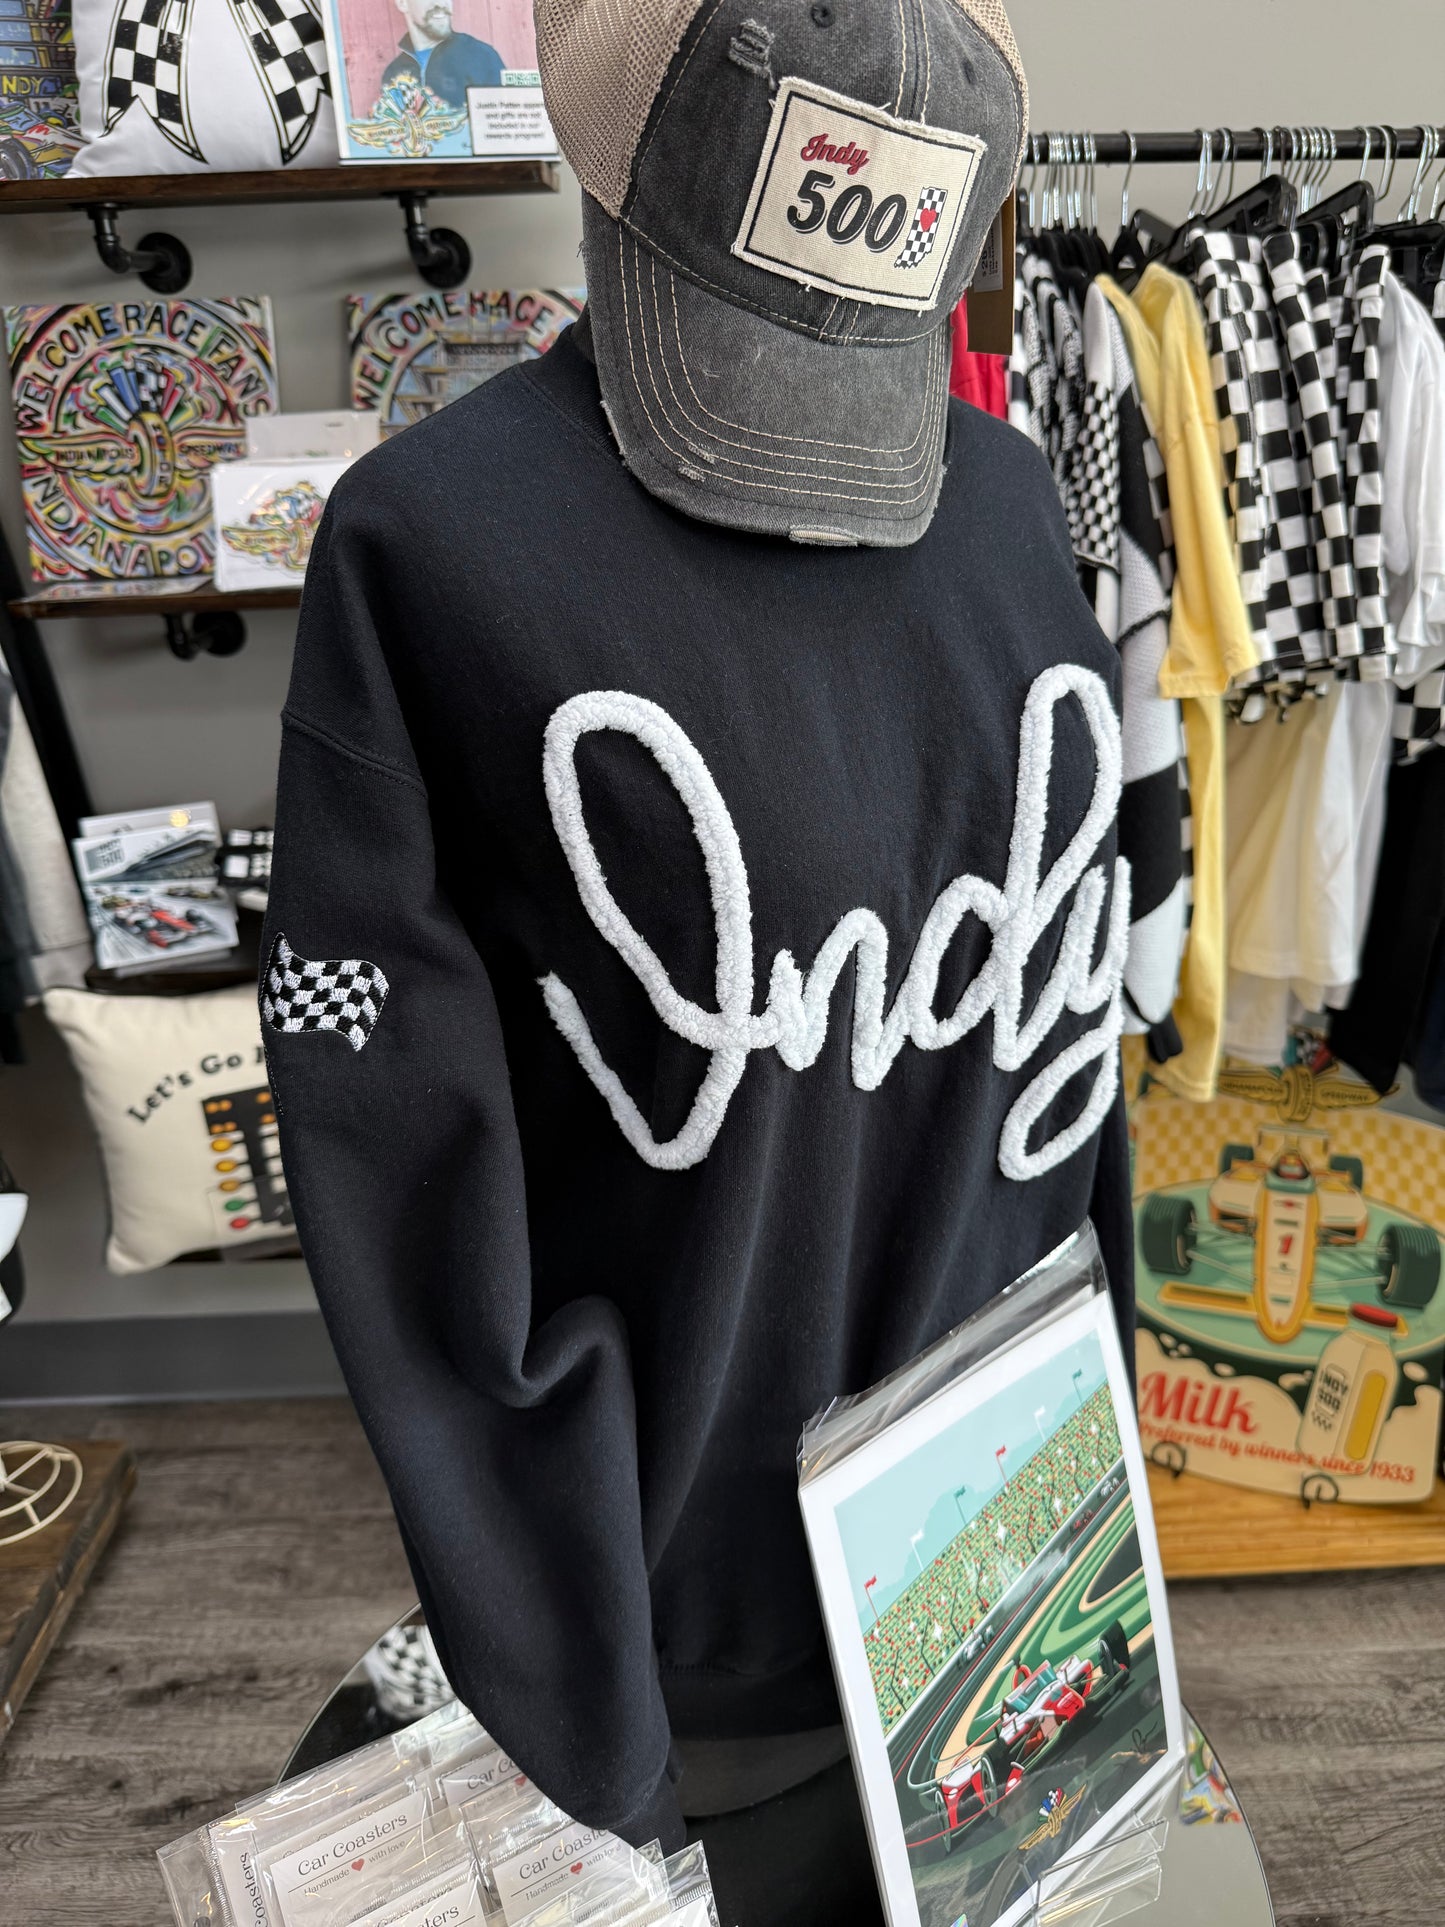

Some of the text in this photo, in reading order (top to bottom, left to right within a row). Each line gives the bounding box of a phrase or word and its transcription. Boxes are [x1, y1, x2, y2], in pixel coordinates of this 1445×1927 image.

[1, 75, 42, 95] NDY
[800, 133, 870, 176] Indy
[786, 169, 909, 254] 500
[16, 303, 273, 431] WELCOME RACE FANS
[353, 291, 464, 412] WELCOME
[537, 664, 1132, 1181] Indy
[126, 1069, 193, 1124] Let's
[200, 1053, 243, 1076] Go
[1138, 1371, 1259, 1435] Milk
[1220, 1433, 1241, 1457] by
[1244, 1441, 1316, 1467] winners
[1320, 1454, 1366, 1474] since
[1370, 1461, 1417, 1484] 1933
[467, 1767, 495, 1790] Car
[298, 1814, 408, 1876] Car Coasters
[303, 1868, 350, 1895] Handmade
[368, 1850, 388, 1864] with
[519, 1829, 608, 1880] Car Coaste
[525, 1872, 569, 1901] Handmade
